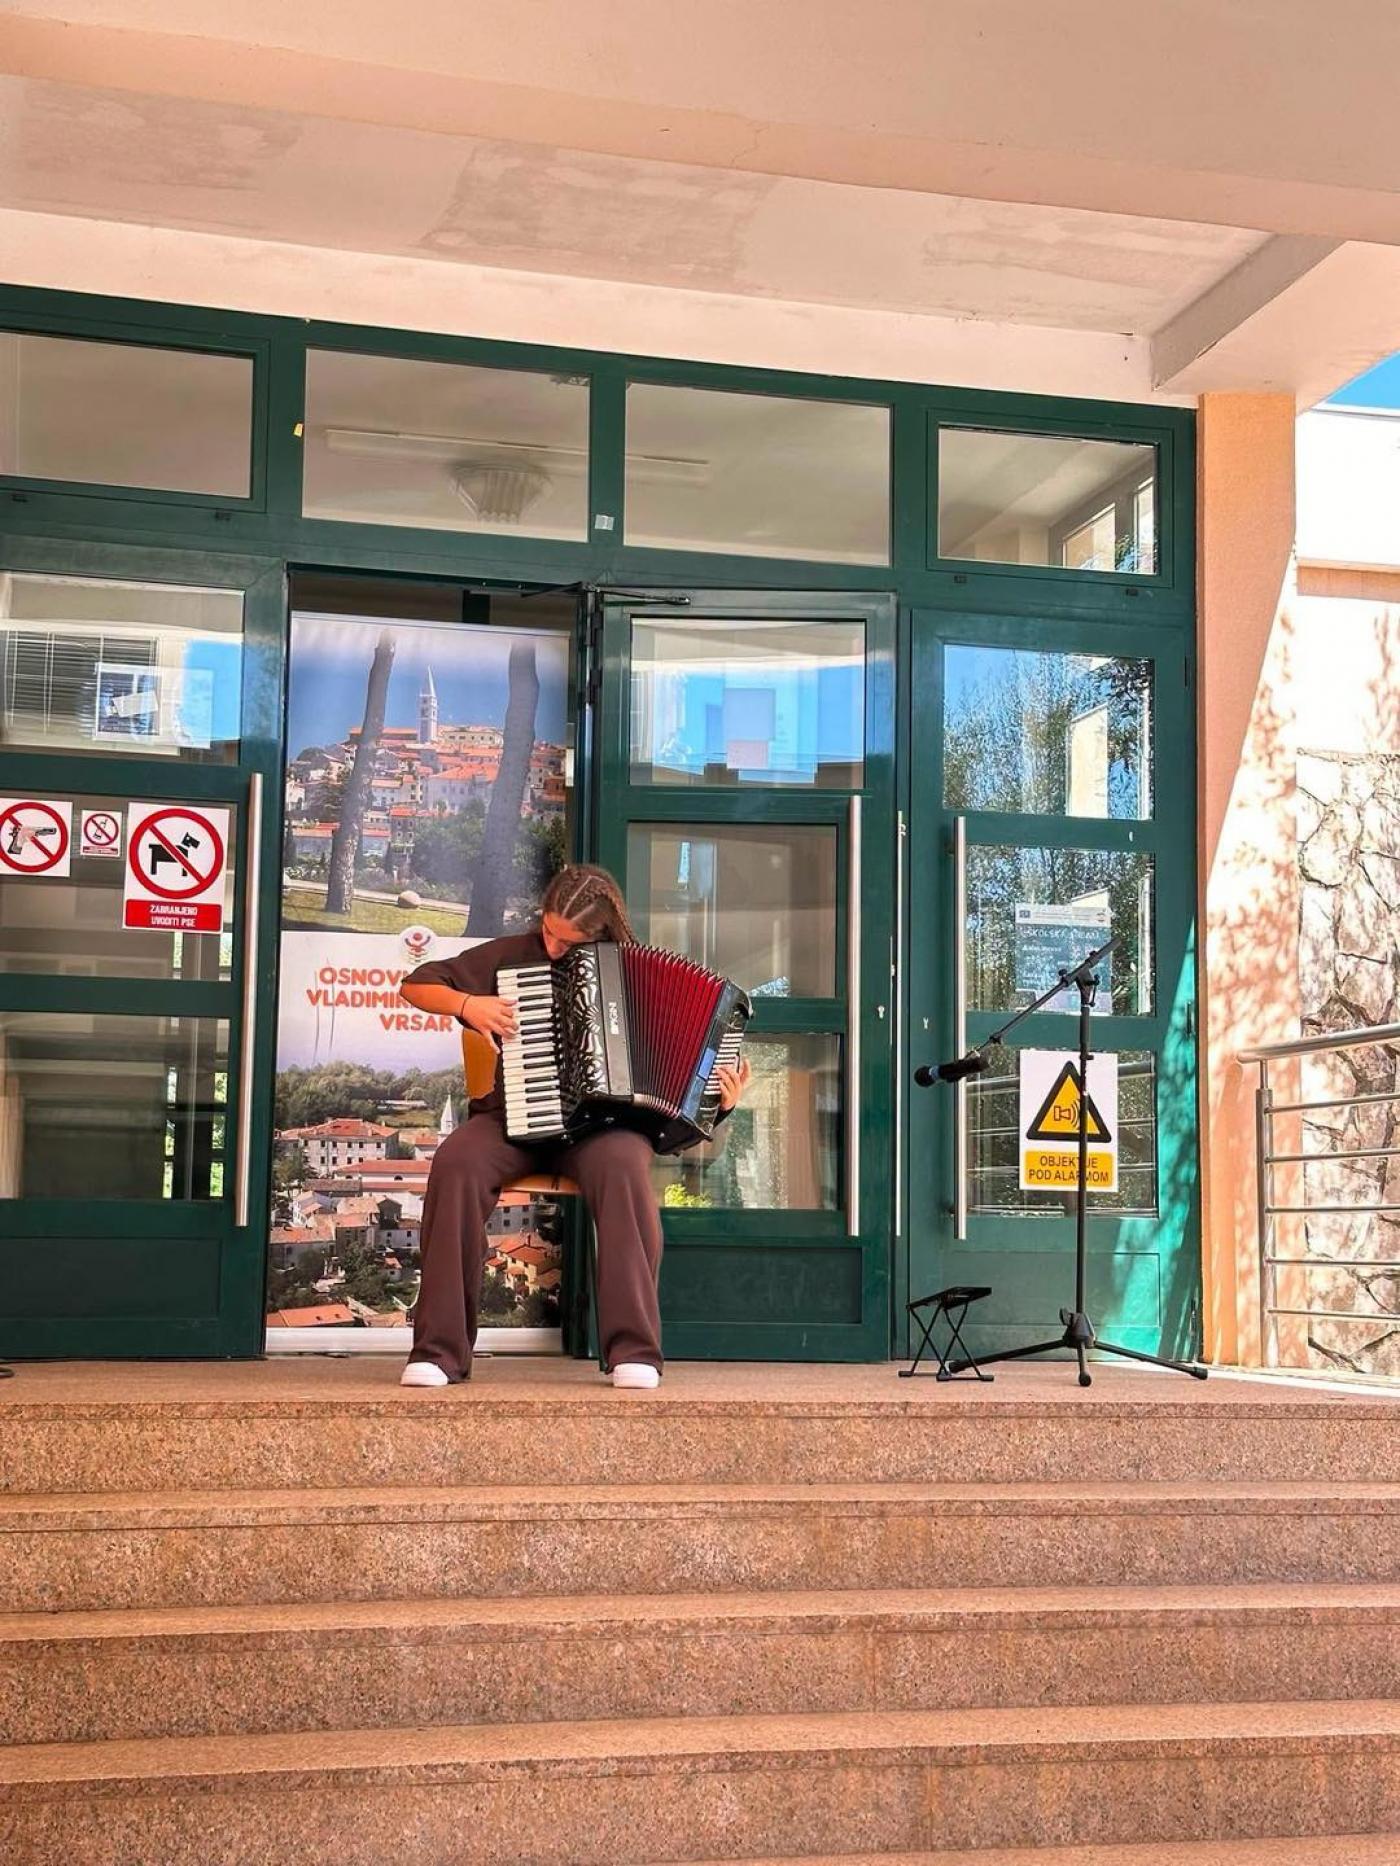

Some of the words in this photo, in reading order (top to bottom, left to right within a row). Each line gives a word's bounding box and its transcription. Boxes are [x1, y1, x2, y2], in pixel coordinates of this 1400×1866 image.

[150, 904, 198, 915] ZABRANJENO
[152, 916, 179, 926] UVODITI
[181, 918, 196, 927] PSE
[319, 967, 409, 986] OSNOV
[379, 1013, 453, 1032] VRSAR
[1086, 1157, 1098, 1169] JE
[1028, 1169, 1051, 1180] POD
